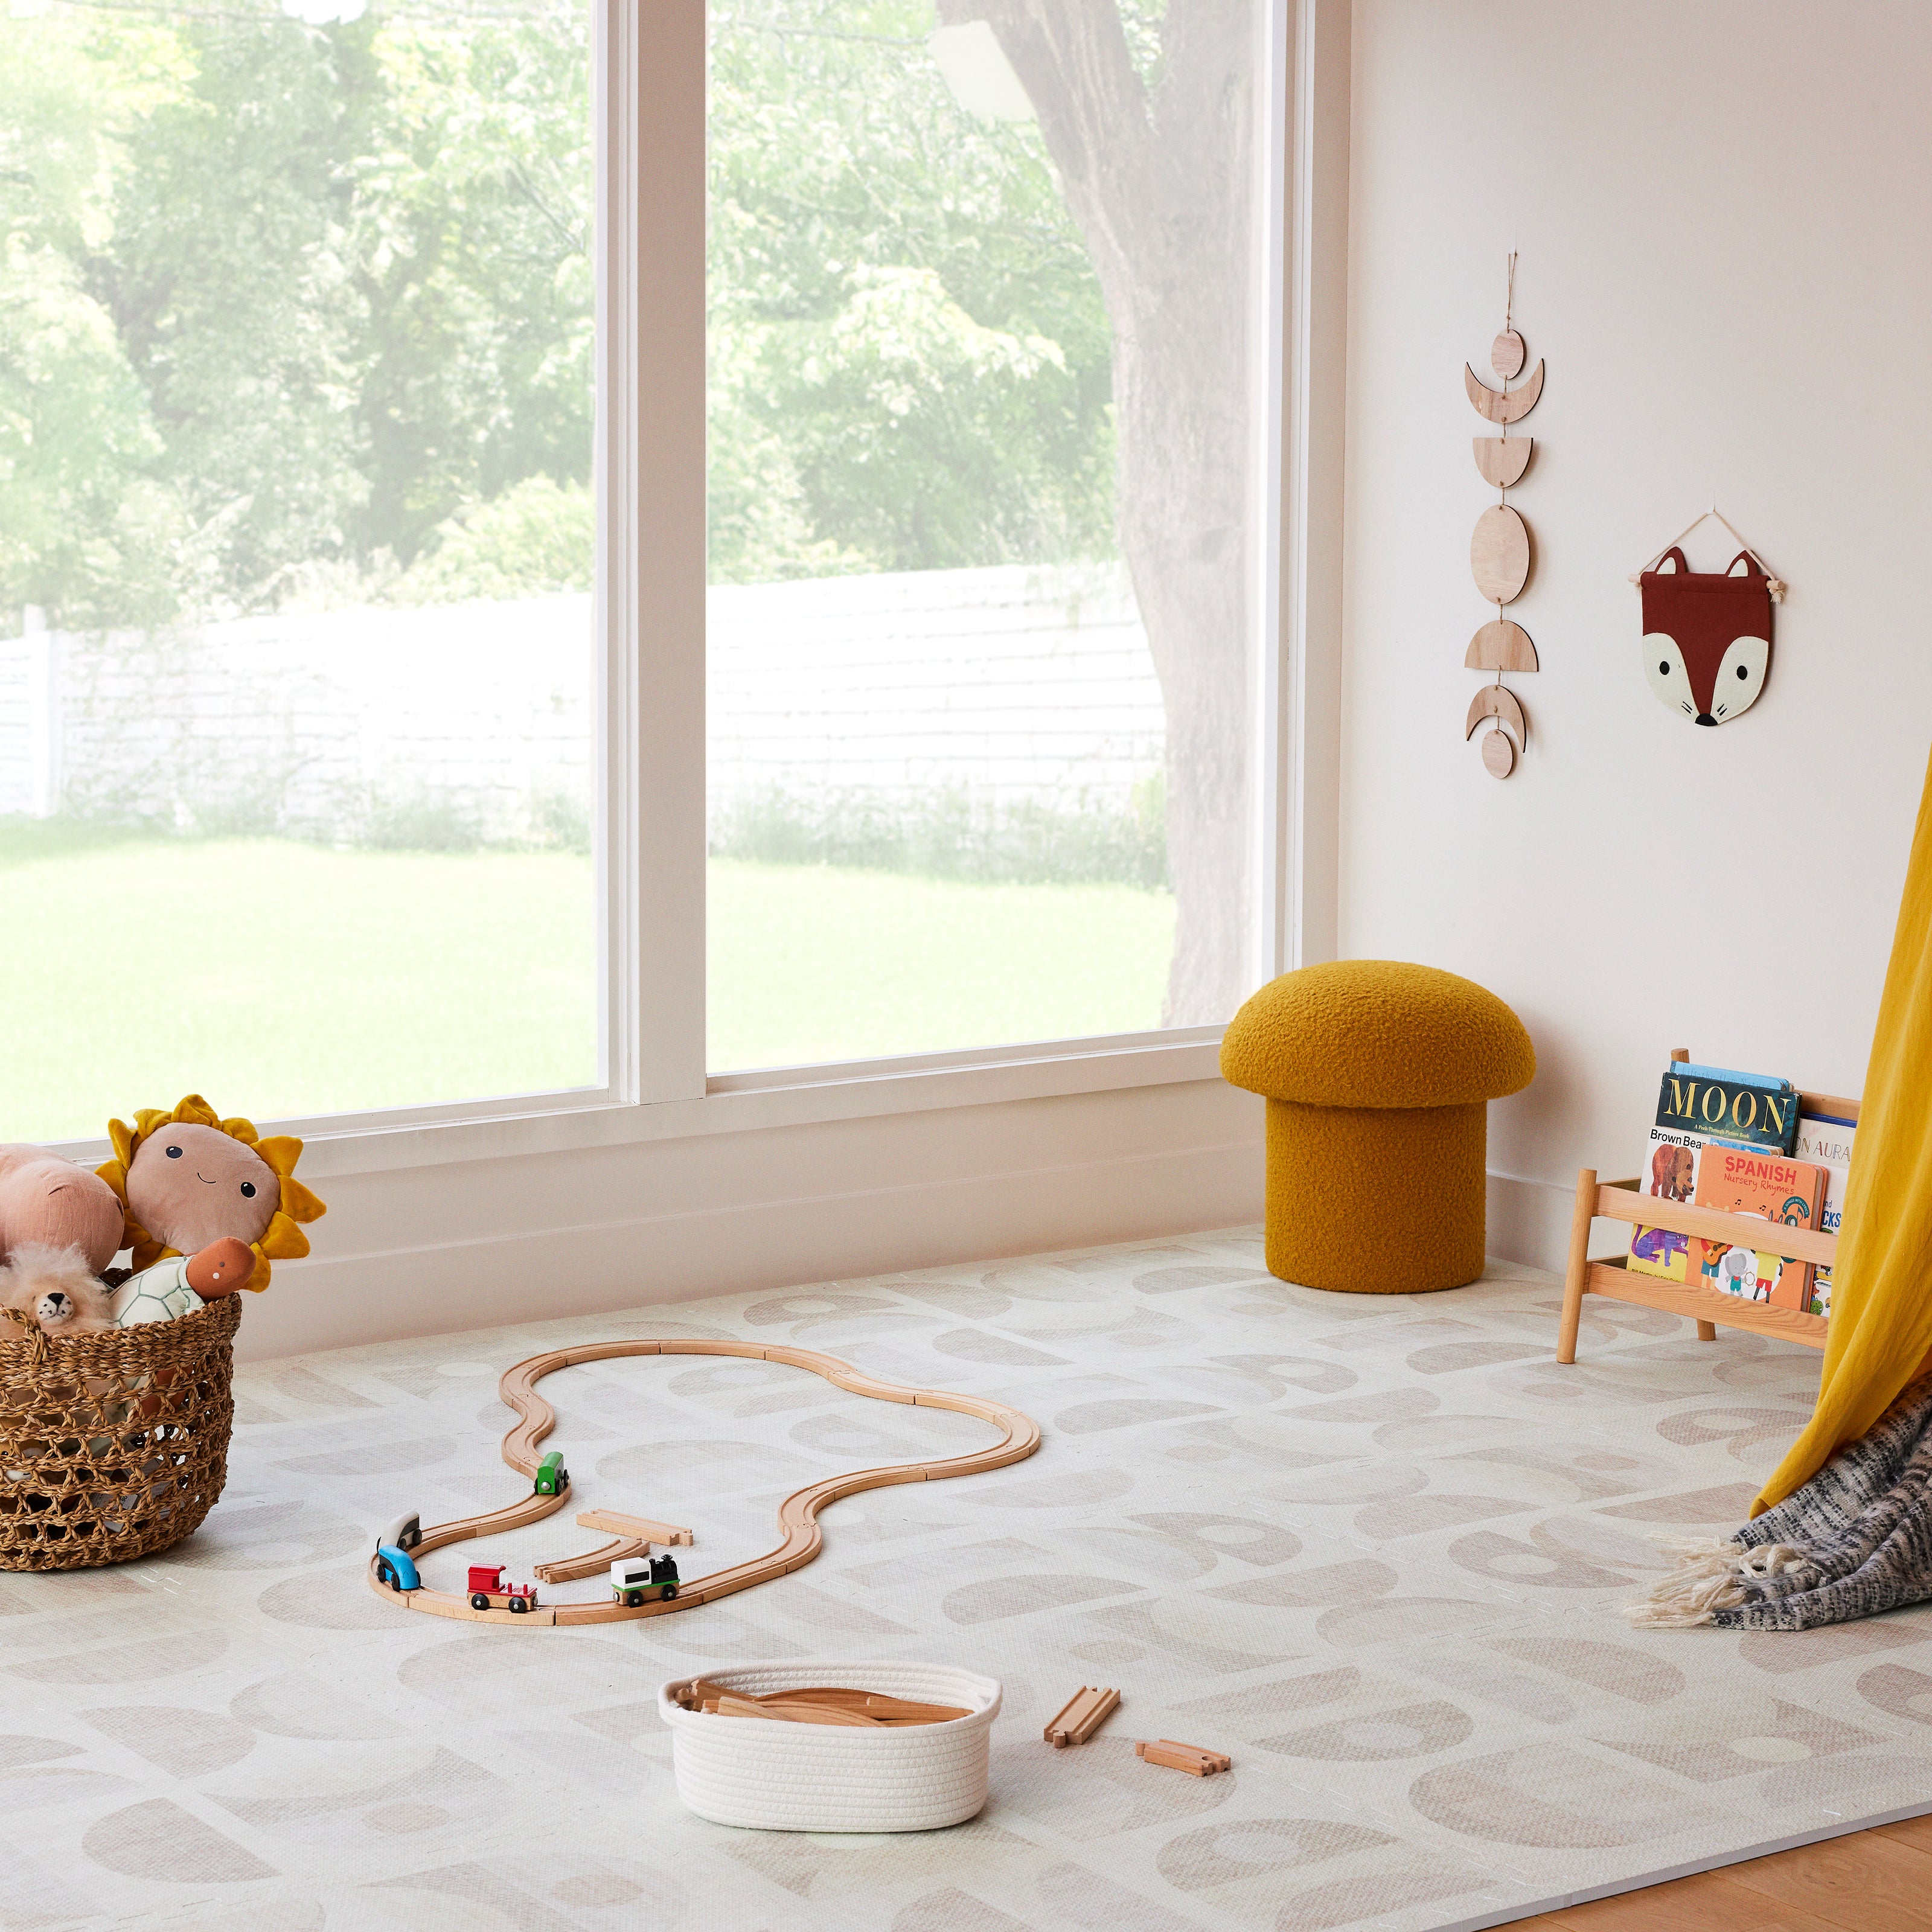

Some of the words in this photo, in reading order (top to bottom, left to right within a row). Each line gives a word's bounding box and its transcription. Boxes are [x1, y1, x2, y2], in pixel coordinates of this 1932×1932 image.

[1663, 1078, 1792, 1135] MOON
[1650, 1129, 1681, 1145] Brown
[1683, 1136, 1706, 1149] Bea
[1698, 1125, 1725, 1134] Peek-Through
[1725, 1156, 1797, 1185] SPANISH
[1724, 1173, 1758, 1192] Nursery
[1761, 1180, 1794, 1196] Rhymes
